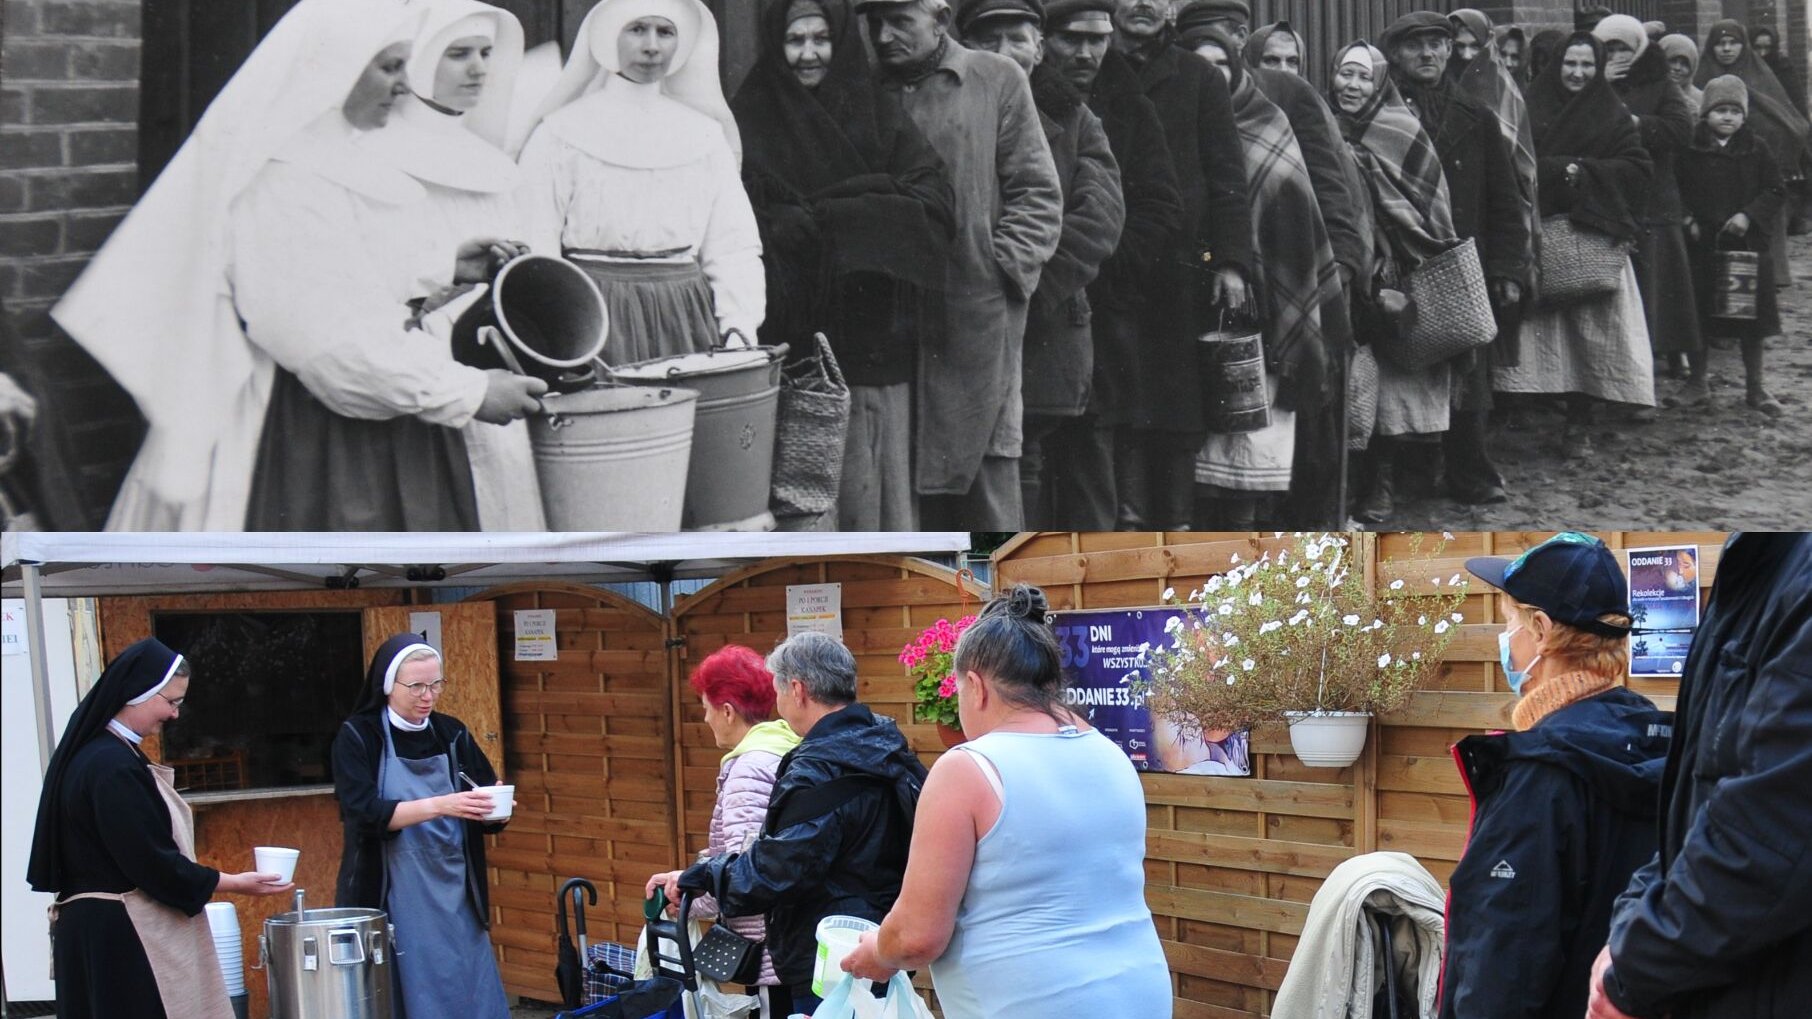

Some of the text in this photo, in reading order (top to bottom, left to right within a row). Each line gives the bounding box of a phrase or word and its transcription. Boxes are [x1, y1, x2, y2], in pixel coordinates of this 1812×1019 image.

[1632, 556, 1673, 566] ODDANIE 33
[1632, 589, 1665, 598] Rekolekcje
[1090, 625, 1112, 642] DNI
[1055, 625, 1090, 668] 33
[1091, 645, 1106, 654] które
[1106, 646, 1121, 655] mogą
[1062, 687, 1145, 710] DDANIE33.pl
